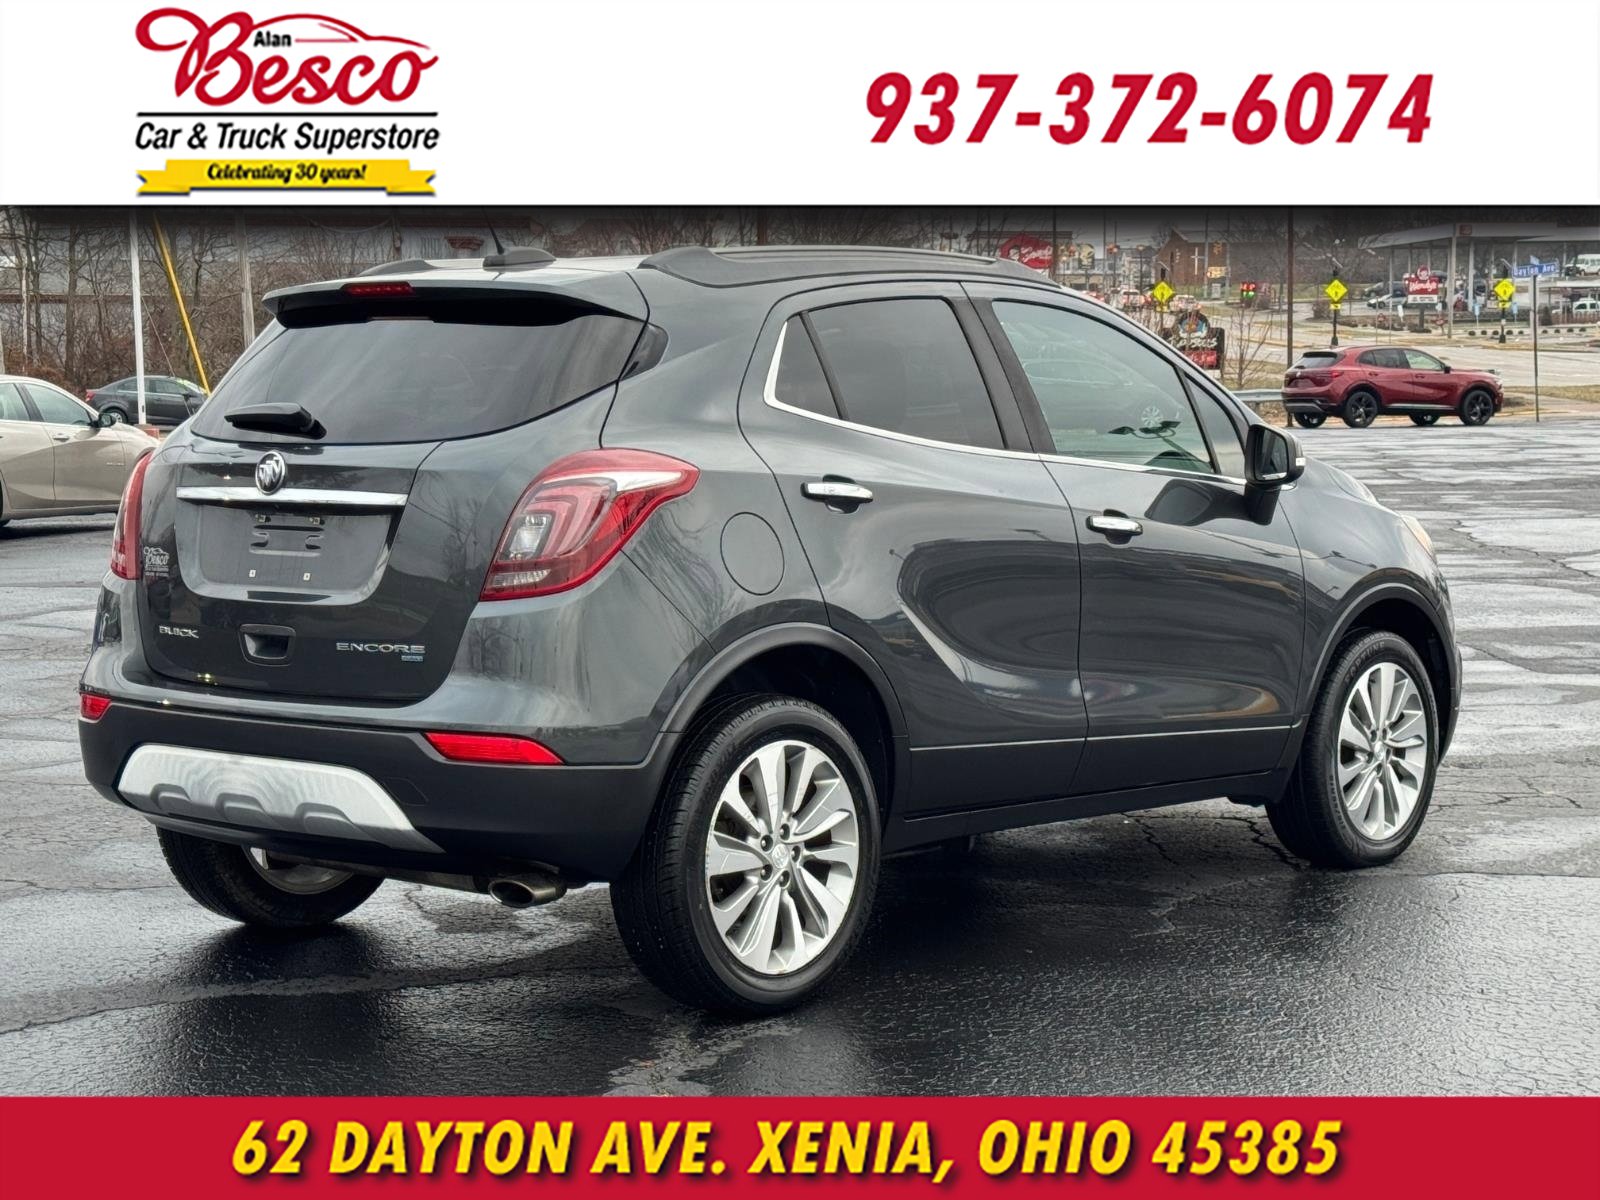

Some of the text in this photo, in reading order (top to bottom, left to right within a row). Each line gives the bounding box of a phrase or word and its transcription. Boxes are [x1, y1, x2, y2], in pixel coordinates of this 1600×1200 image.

[1513, 264, 1556, 276] Dayton Ave
[158, 625, 200, 640] BUICK
[336, 642, 426, 654] ENCORE
